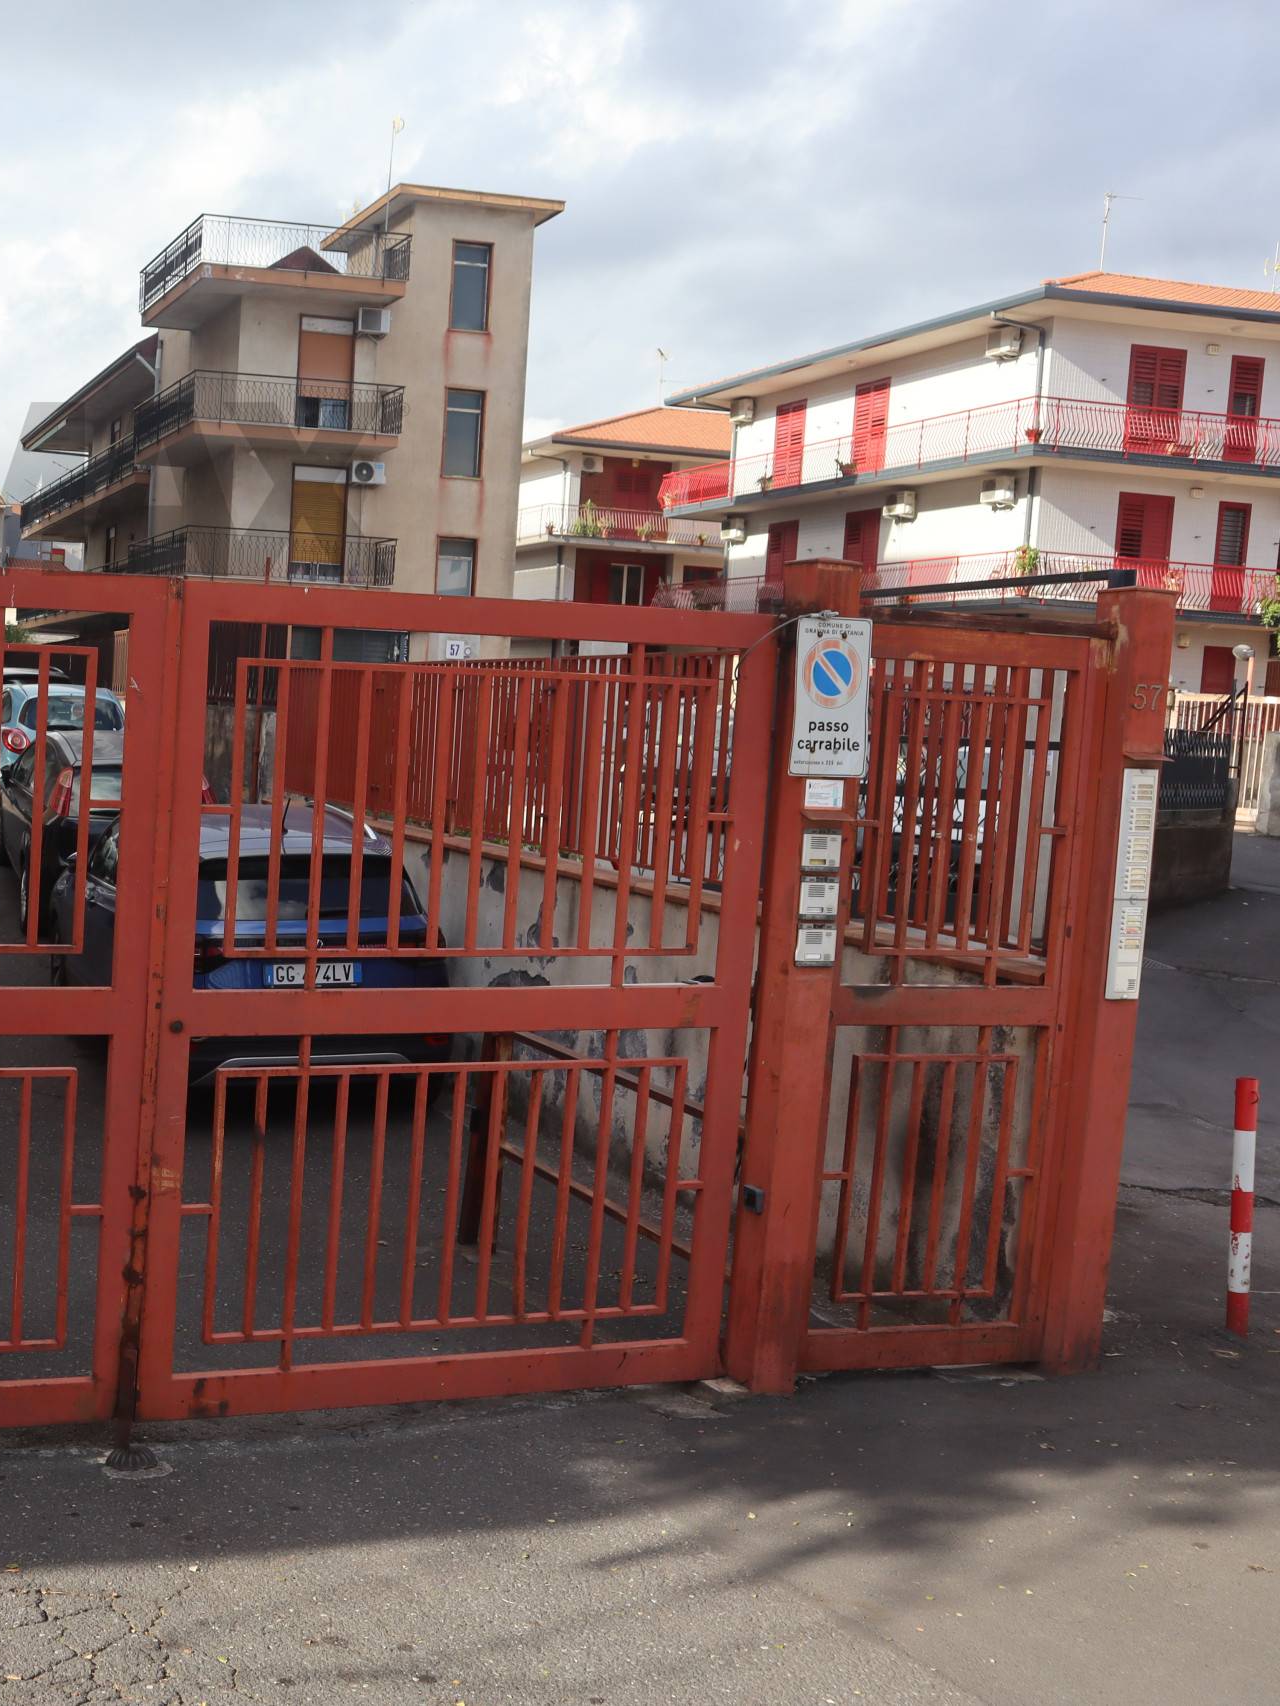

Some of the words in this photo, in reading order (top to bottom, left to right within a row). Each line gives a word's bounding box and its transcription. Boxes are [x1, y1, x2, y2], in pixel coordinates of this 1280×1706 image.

[450, 644, 460, 656] 57
[1133, 684, 1163, 711] 57
[808, 721, 849, 733] passo
[797, 737, 860, 751] carrabile
